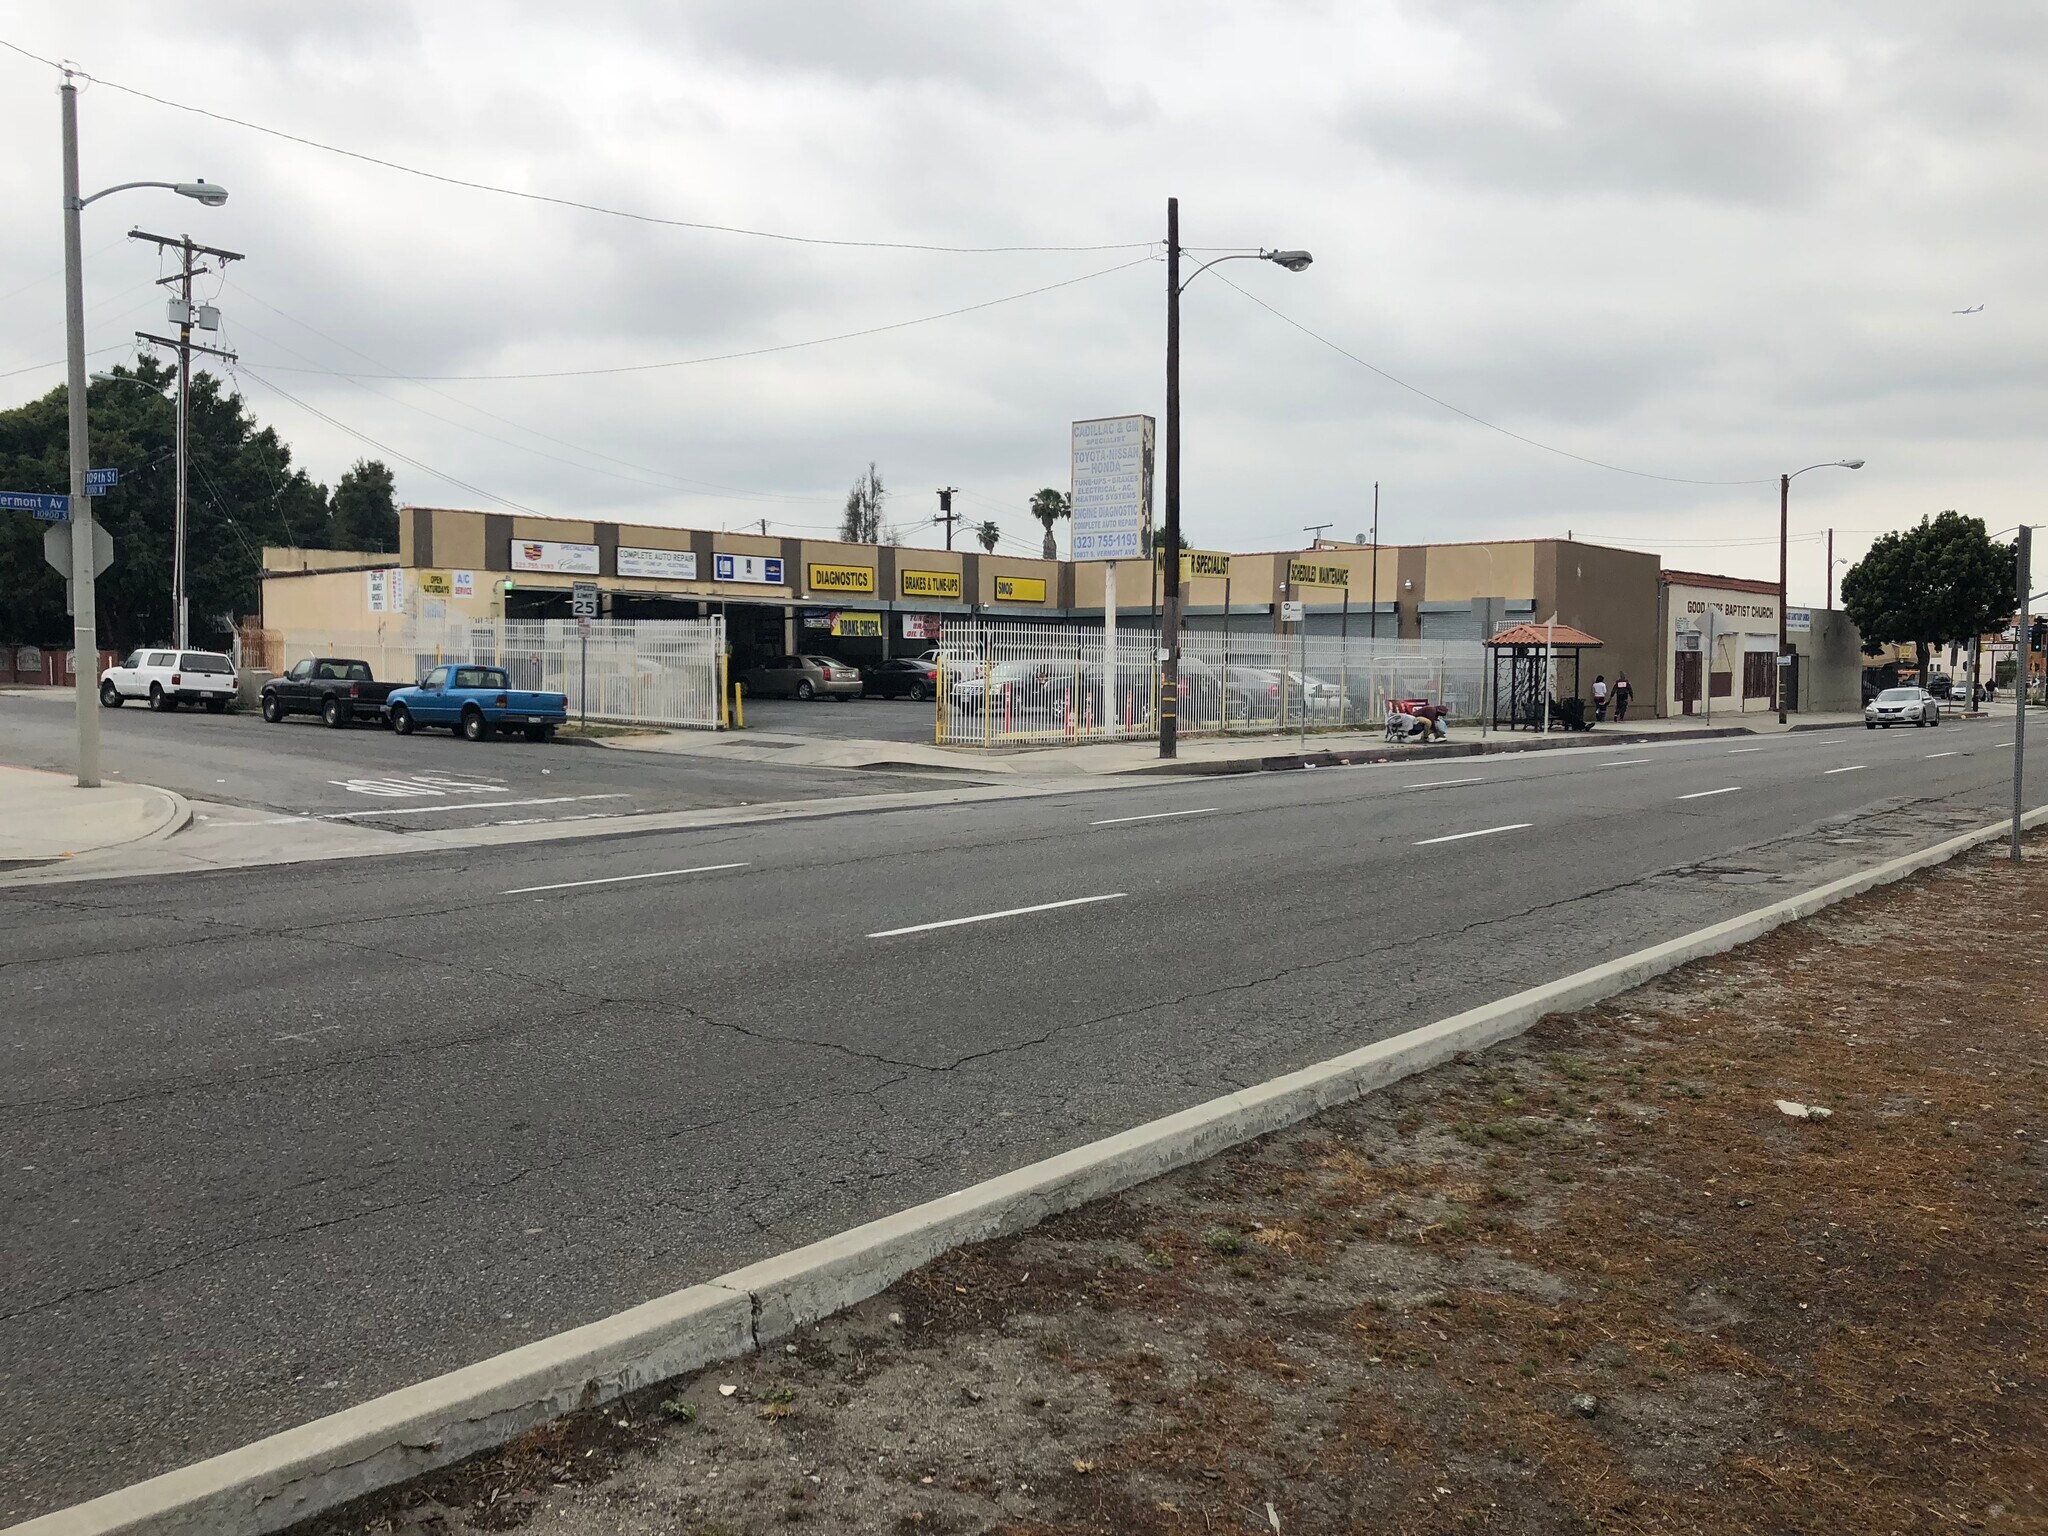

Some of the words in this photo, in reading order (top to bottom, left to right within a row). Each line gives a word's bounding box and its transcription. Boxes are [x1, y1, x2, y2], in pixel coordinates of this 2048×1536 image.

[1074, 423, 1114, 437] CADILLAC
[1117, 422, 1123, 433] &
[1126, 420, 1139, 432] GM
[1086, 435, 1126, 445] SPECIALIST
[1091, 461, 1121, 474] HONDA
[86, 472, 105, 483] 109th
[107, 471, 115, 483] St
[1077, 485, 1117, 494] ELECTRICAL
[0, 496, 42, 507] ermont
[49, 498, 62, 509] Av
[1075, 494, 1104, 503] HEATING
[1105, 492, 1136, 501] SYSTEMS
[37, 510, 60, 519] 10900
[62, 512, 67, 520] S
[1074, 507, 1097, 519] ENGINE
[1099, 504, 1138, 518] DIAGNOSTIC
[1074, 520, 1100, 530] COMPLETE
[1102, 520, 1117, 528] AUTO
[1118, 518, 1137, 527] REPAIR
[1074, 536, 1095, 549] (323)
[1097, 533, 1137, 547] 755-1193
[620, 550, 653, 559] COMPLETE
[673, 553, 694, 562] REPAIR
[1097, 549, 1122, 557] VERMONT
[1196, 554, 1230, 575] SPECIALIST
[430, 575, 443, 584] OPEN
[457, 573, 470, 584] A/C
[816, 570, 868, 587] DIAGNOSTICS
[1291, 564, 1316, 583] SCHEDULED
[1318, 566, 1349, 586] MAINTENANCE
[423, 584, 450, 594] SATURDAYS
[905, 576, 926, 590] BRAKES
[927, 577, 932, 590] &
[932, 577, 958, 592] TUNE-UPS
[455, 587, 473, 595] SERVICE
[574, 601, 595, 614] 25
[1687, 601, 1706, 613] GOOD
[1724, 603, 1750, 617] BAPTIST
[1751, 605, 1774, 619] CHURCH
[840, 620, 859, 635] BRAKE
[860, 620, 879, 636] CHECK
